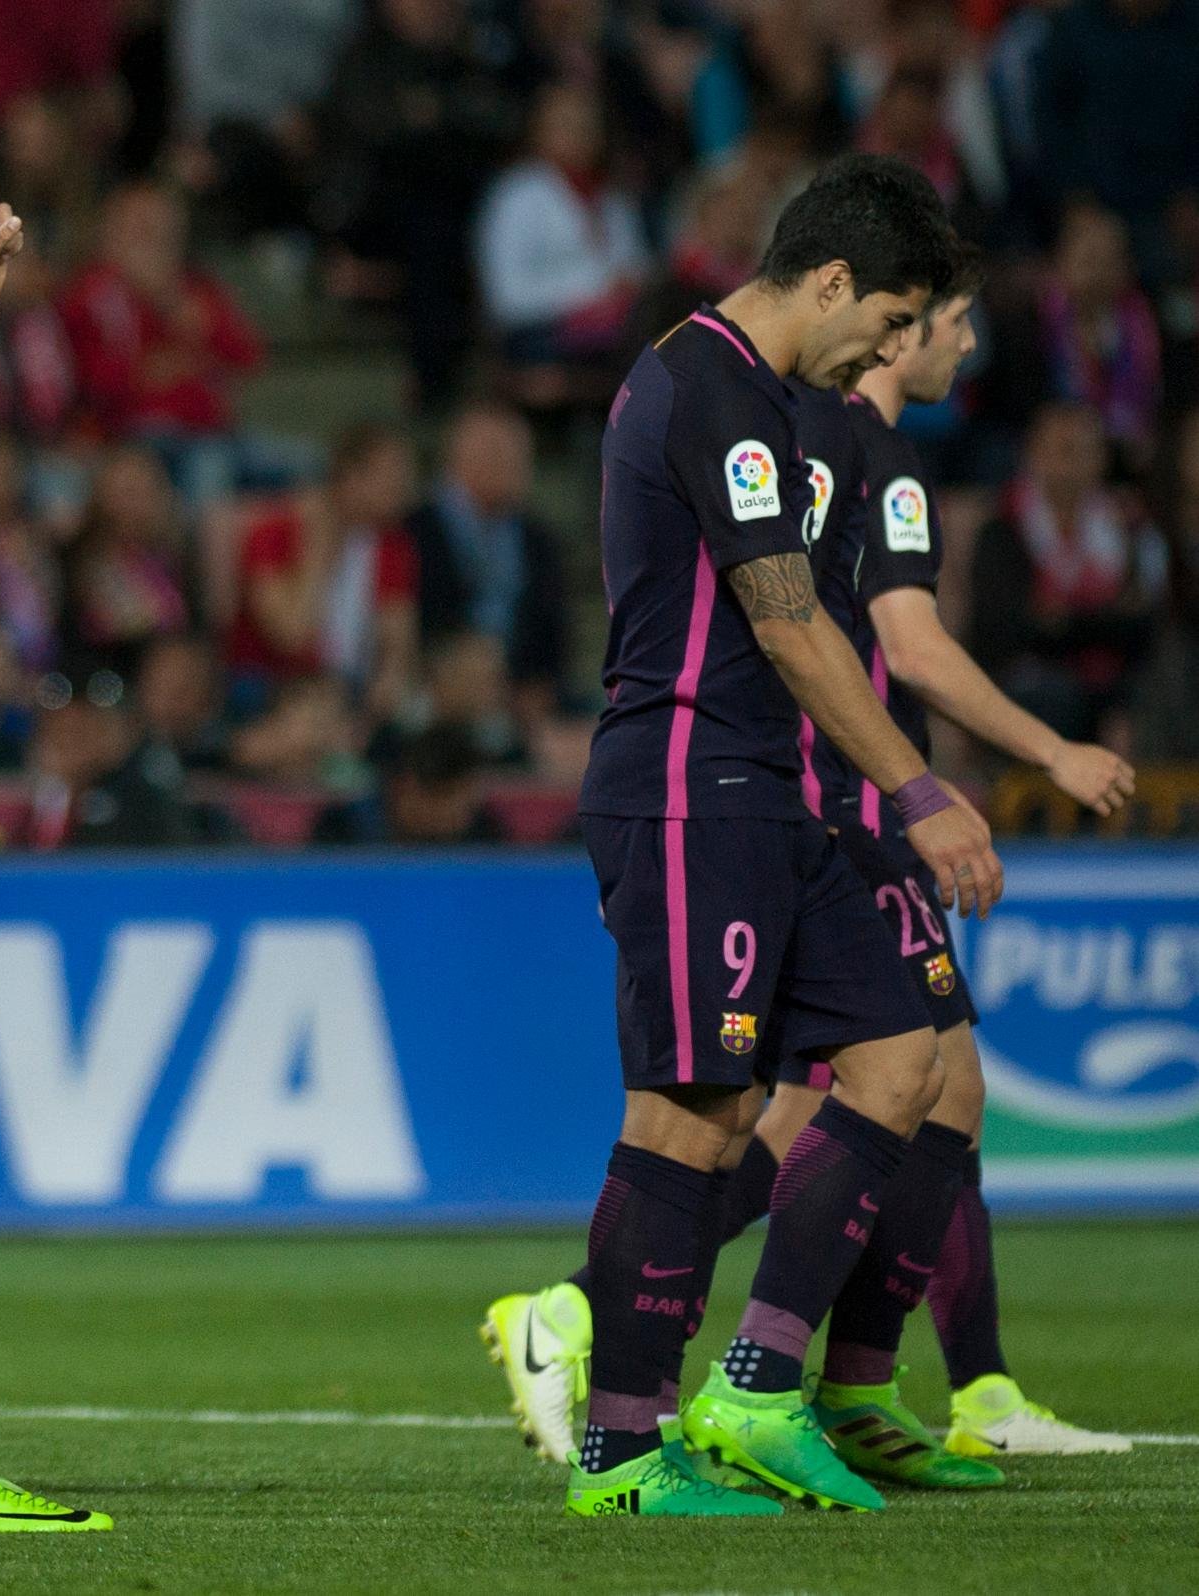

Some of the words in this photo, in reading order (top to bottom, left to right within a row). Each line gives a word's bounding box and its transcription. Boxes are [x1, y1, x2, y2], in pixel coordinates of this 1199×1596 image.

[737, 495, 775, 510] LaLiga
[875, 877, 945, 957] 28
[722, 921, 757, 999] 9
